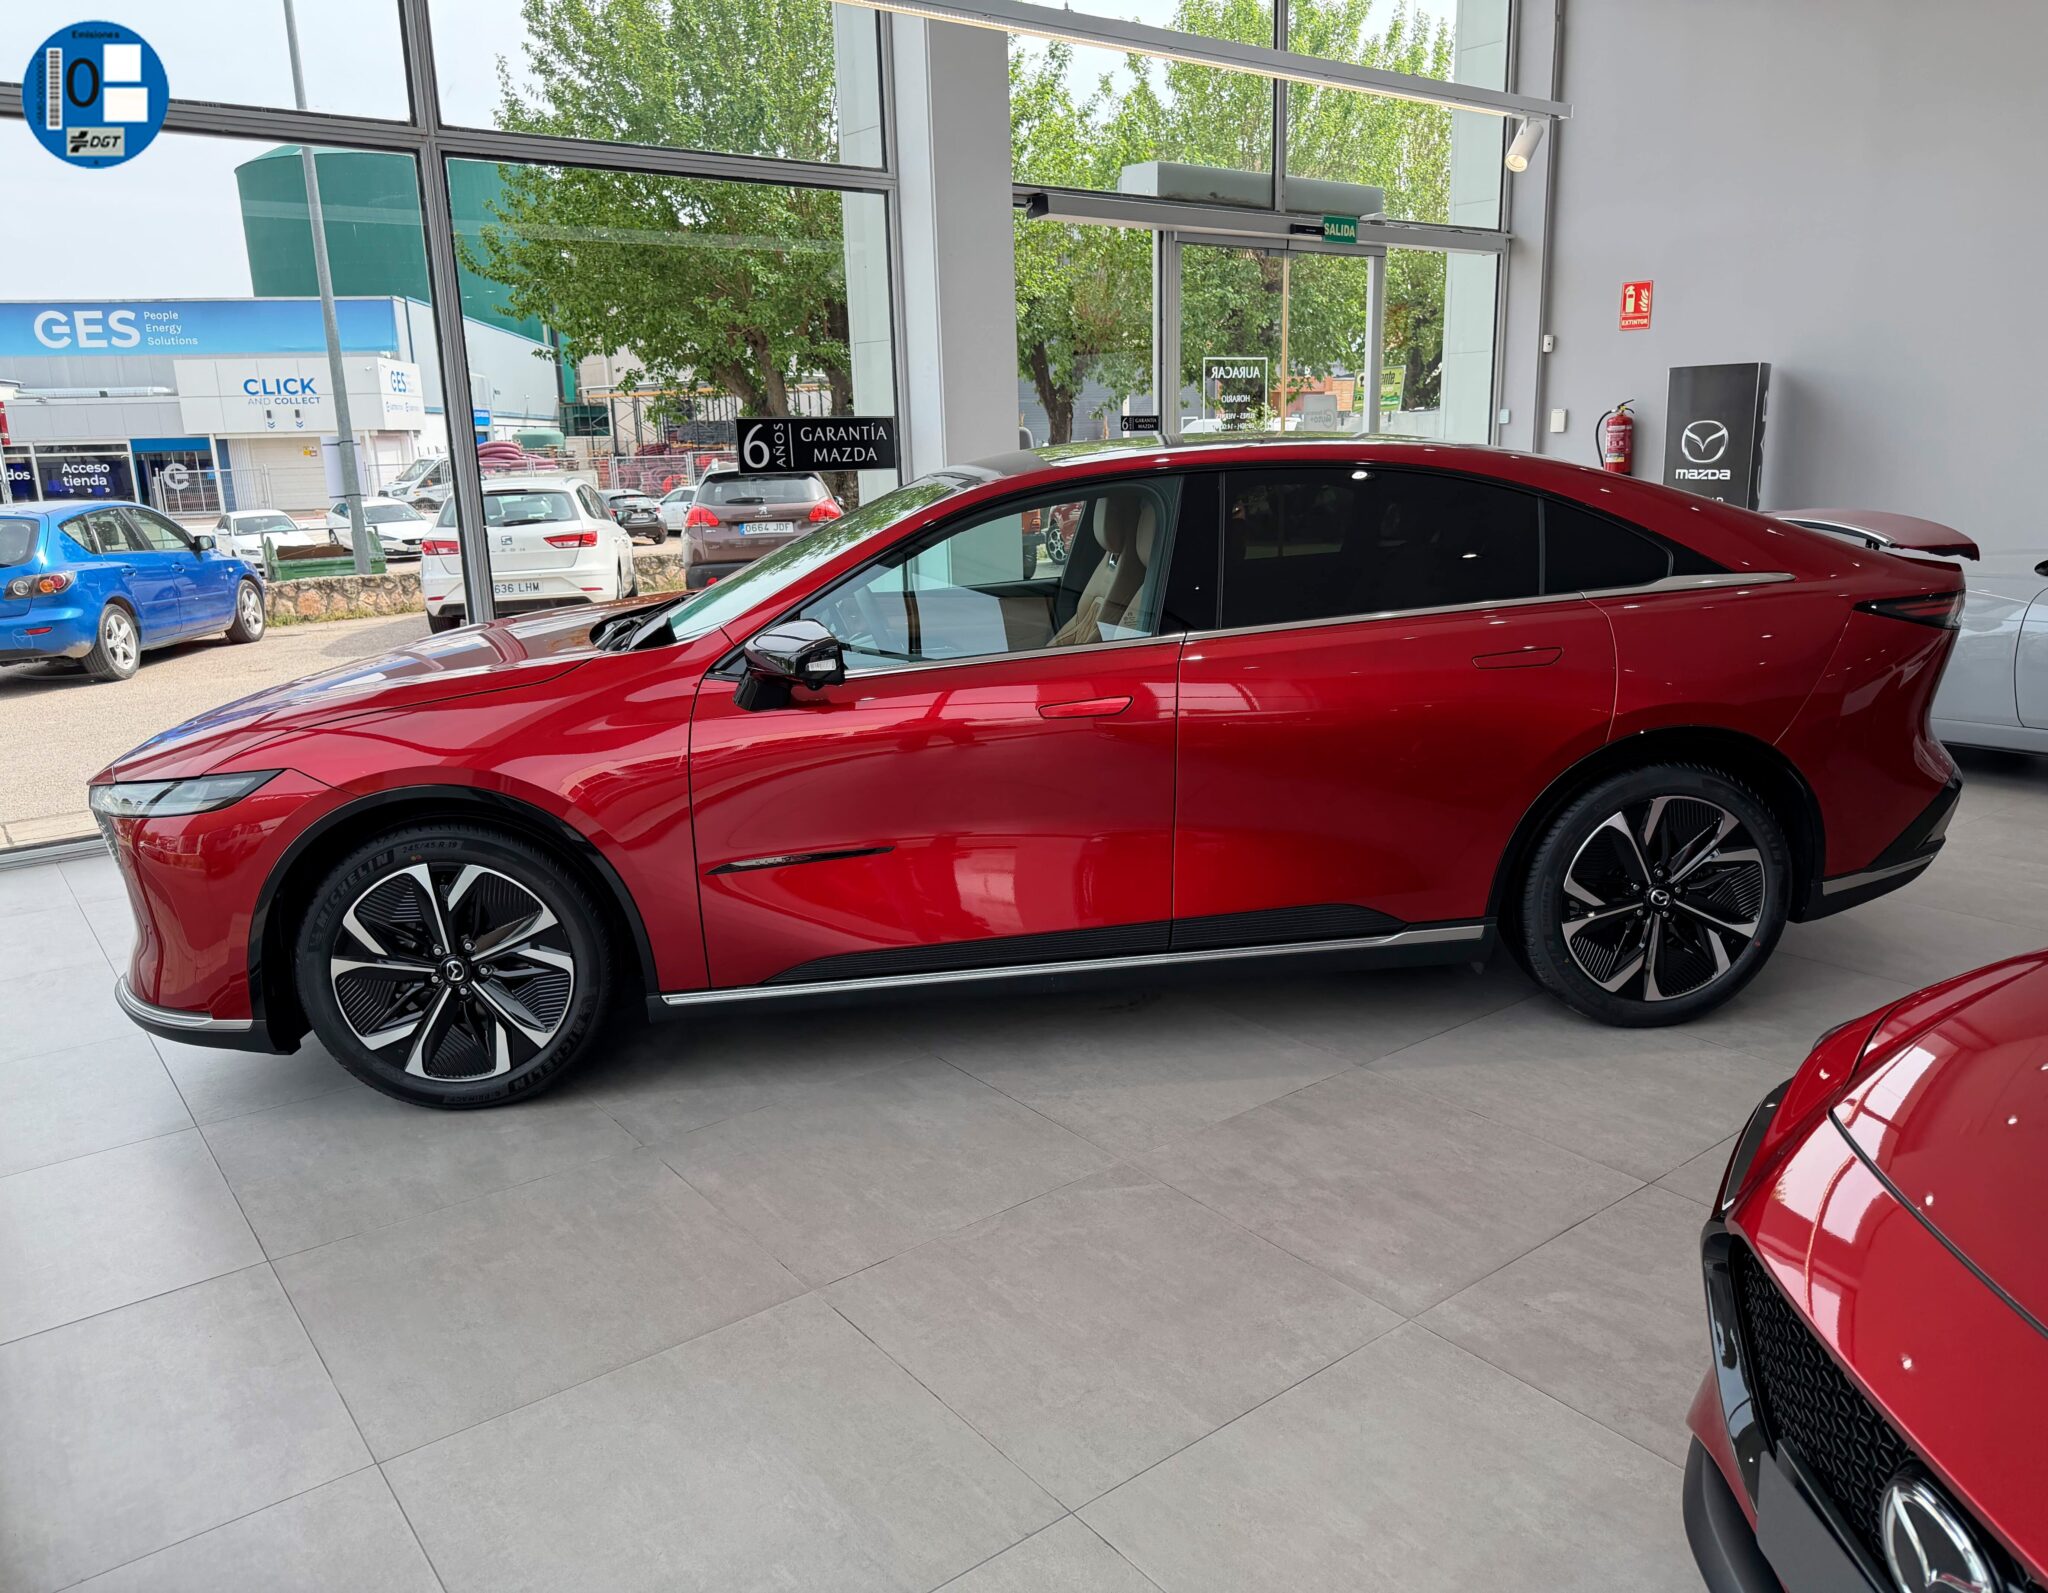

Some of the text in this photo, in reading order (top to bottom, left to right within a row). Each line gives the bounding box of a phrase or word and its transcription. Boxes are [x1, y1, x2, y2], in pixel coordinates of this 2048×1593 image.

[1324, 222, 1356, 238] SALIDA
[143, 311, 179, 321] People
[33, 310, 141, 349] GES
[145, 324, 182, 335] Energy
[147, 336, 199, 346] Solutions
[243, 377, 318, 396] CLICK
[248, 396, 321, 406] AND COLLECT
[1121, 417, 1129, 430] 6
[800, 422, 888, 442] GARANTÍA
[743, 423, 770, 469] 6
[773, 423, 787, 468] AÑOS
[813, 447, 878, 463] MAZDA
[61, 462, 110, 475] Acceso
[62, 475, 108, 487] tienda
[745, 522, 791, 533] 0664 JDF
[495, 582, 540, 594] 636 LHM
[318, 852, 390, 926] MICHELIN
